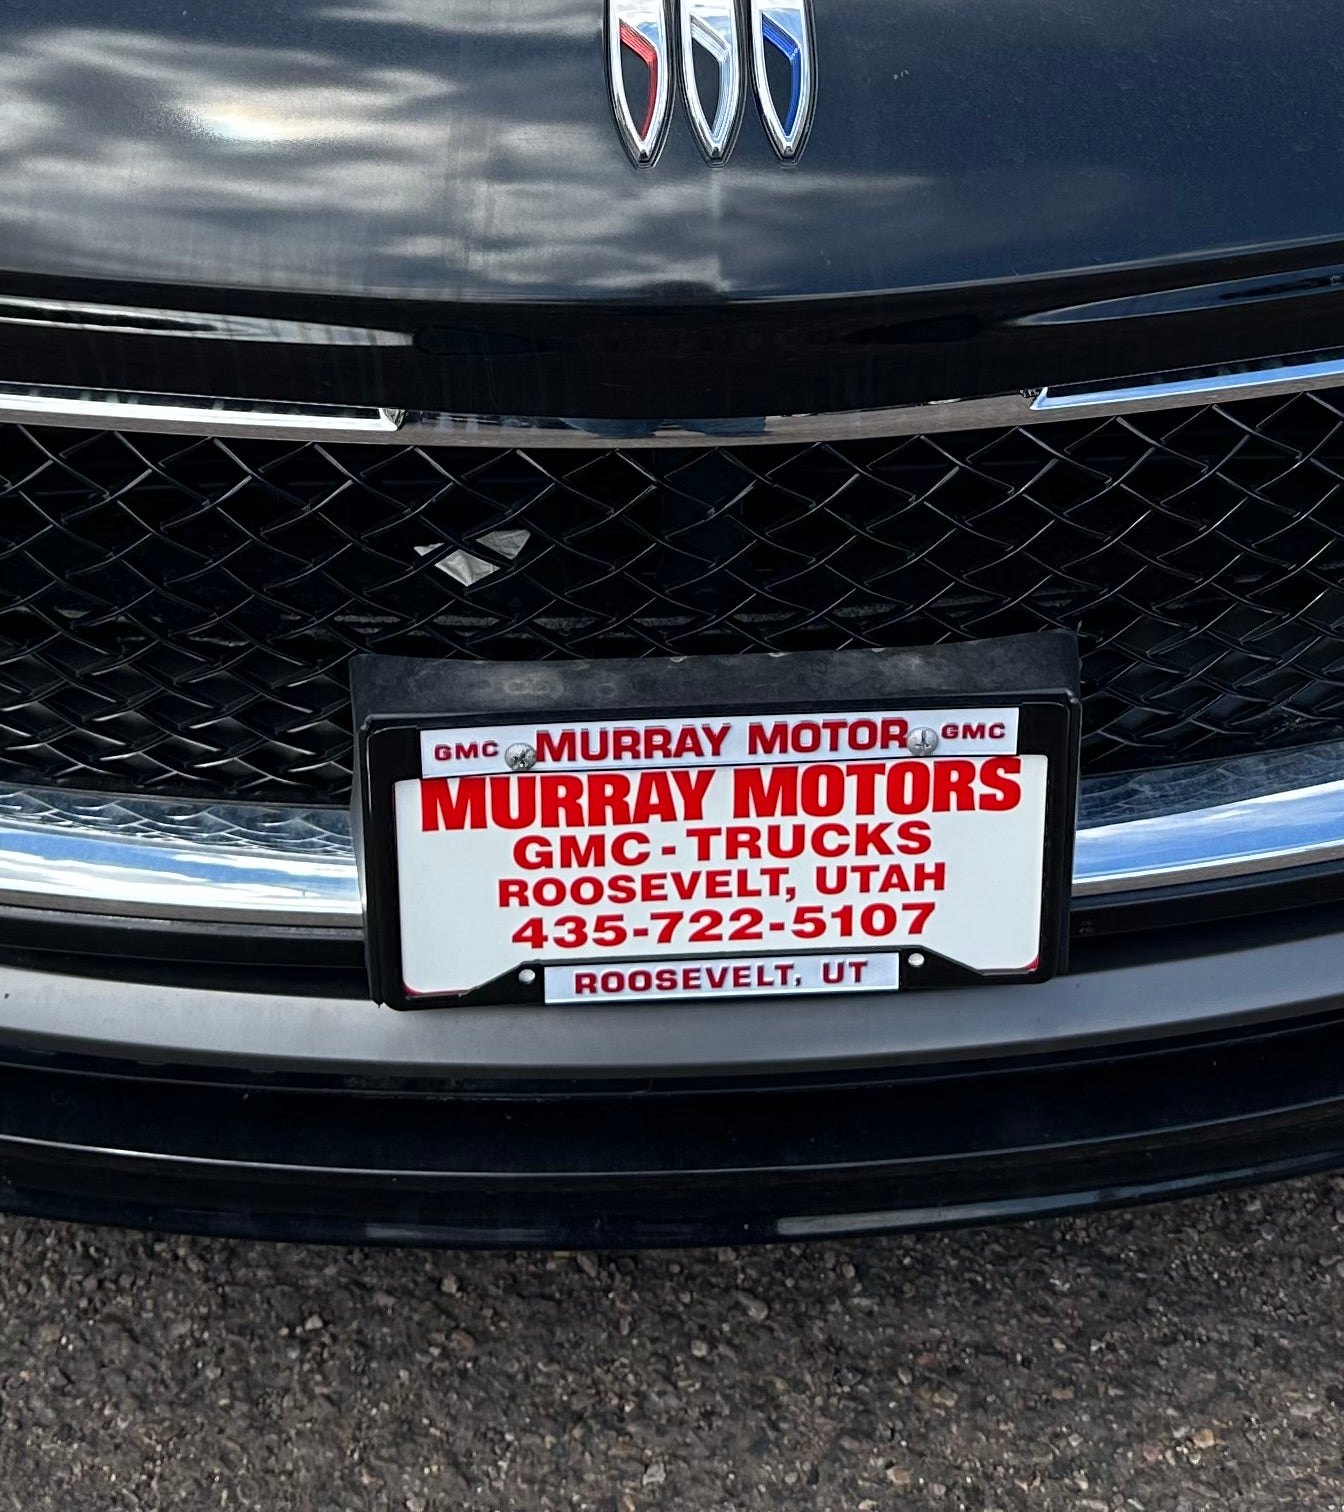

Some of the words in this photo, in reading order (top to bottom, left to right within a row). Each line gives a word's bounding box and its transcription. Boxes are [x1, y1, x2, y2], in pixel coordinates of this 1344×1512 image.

[433, 739, 499, 761] GMC
[536, 723, 732, 762] MURRAY
[748, 717, 909, 755] MOTOR
[940, 722, 1006, 739] GMC
[419, 768, 716, 832] MURRAY
[733, 755, 1022, 819] MOTORS
[498, 867, 796, 908] ROOSEVELT,
[815, 862, 946, 896] UTAH
[511, 902, 935, 950] 435-722-5107
[574, 962, 801, 994] ROOSEVELT,
[822, 960, 869, 985] UT
